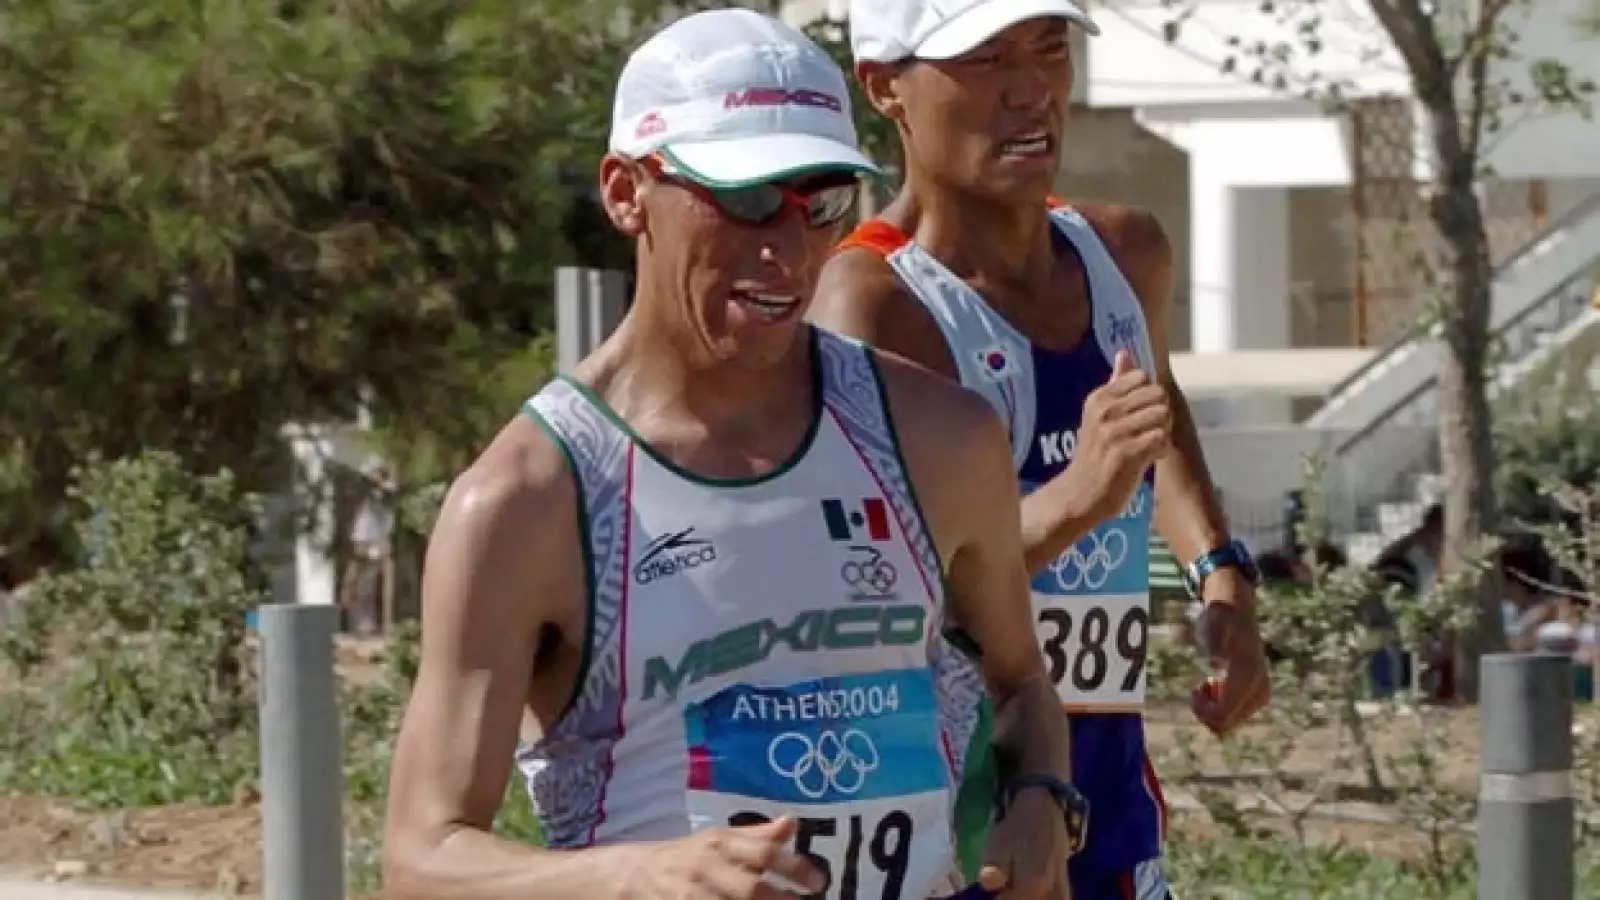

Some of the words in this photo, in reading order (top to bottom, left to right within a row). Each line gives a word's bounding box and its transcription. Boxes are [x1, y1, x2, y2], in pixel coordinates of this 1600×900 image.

[723, 87, 842, 113] MEXICO
[1040, 430, 1078, 464] KO
[634, 546, 716, 585] atletica
[642, 605, 926, 700] MEXICO
[1038, 605, 1147, 692] 389
[728, 809, 913, 900] 519
